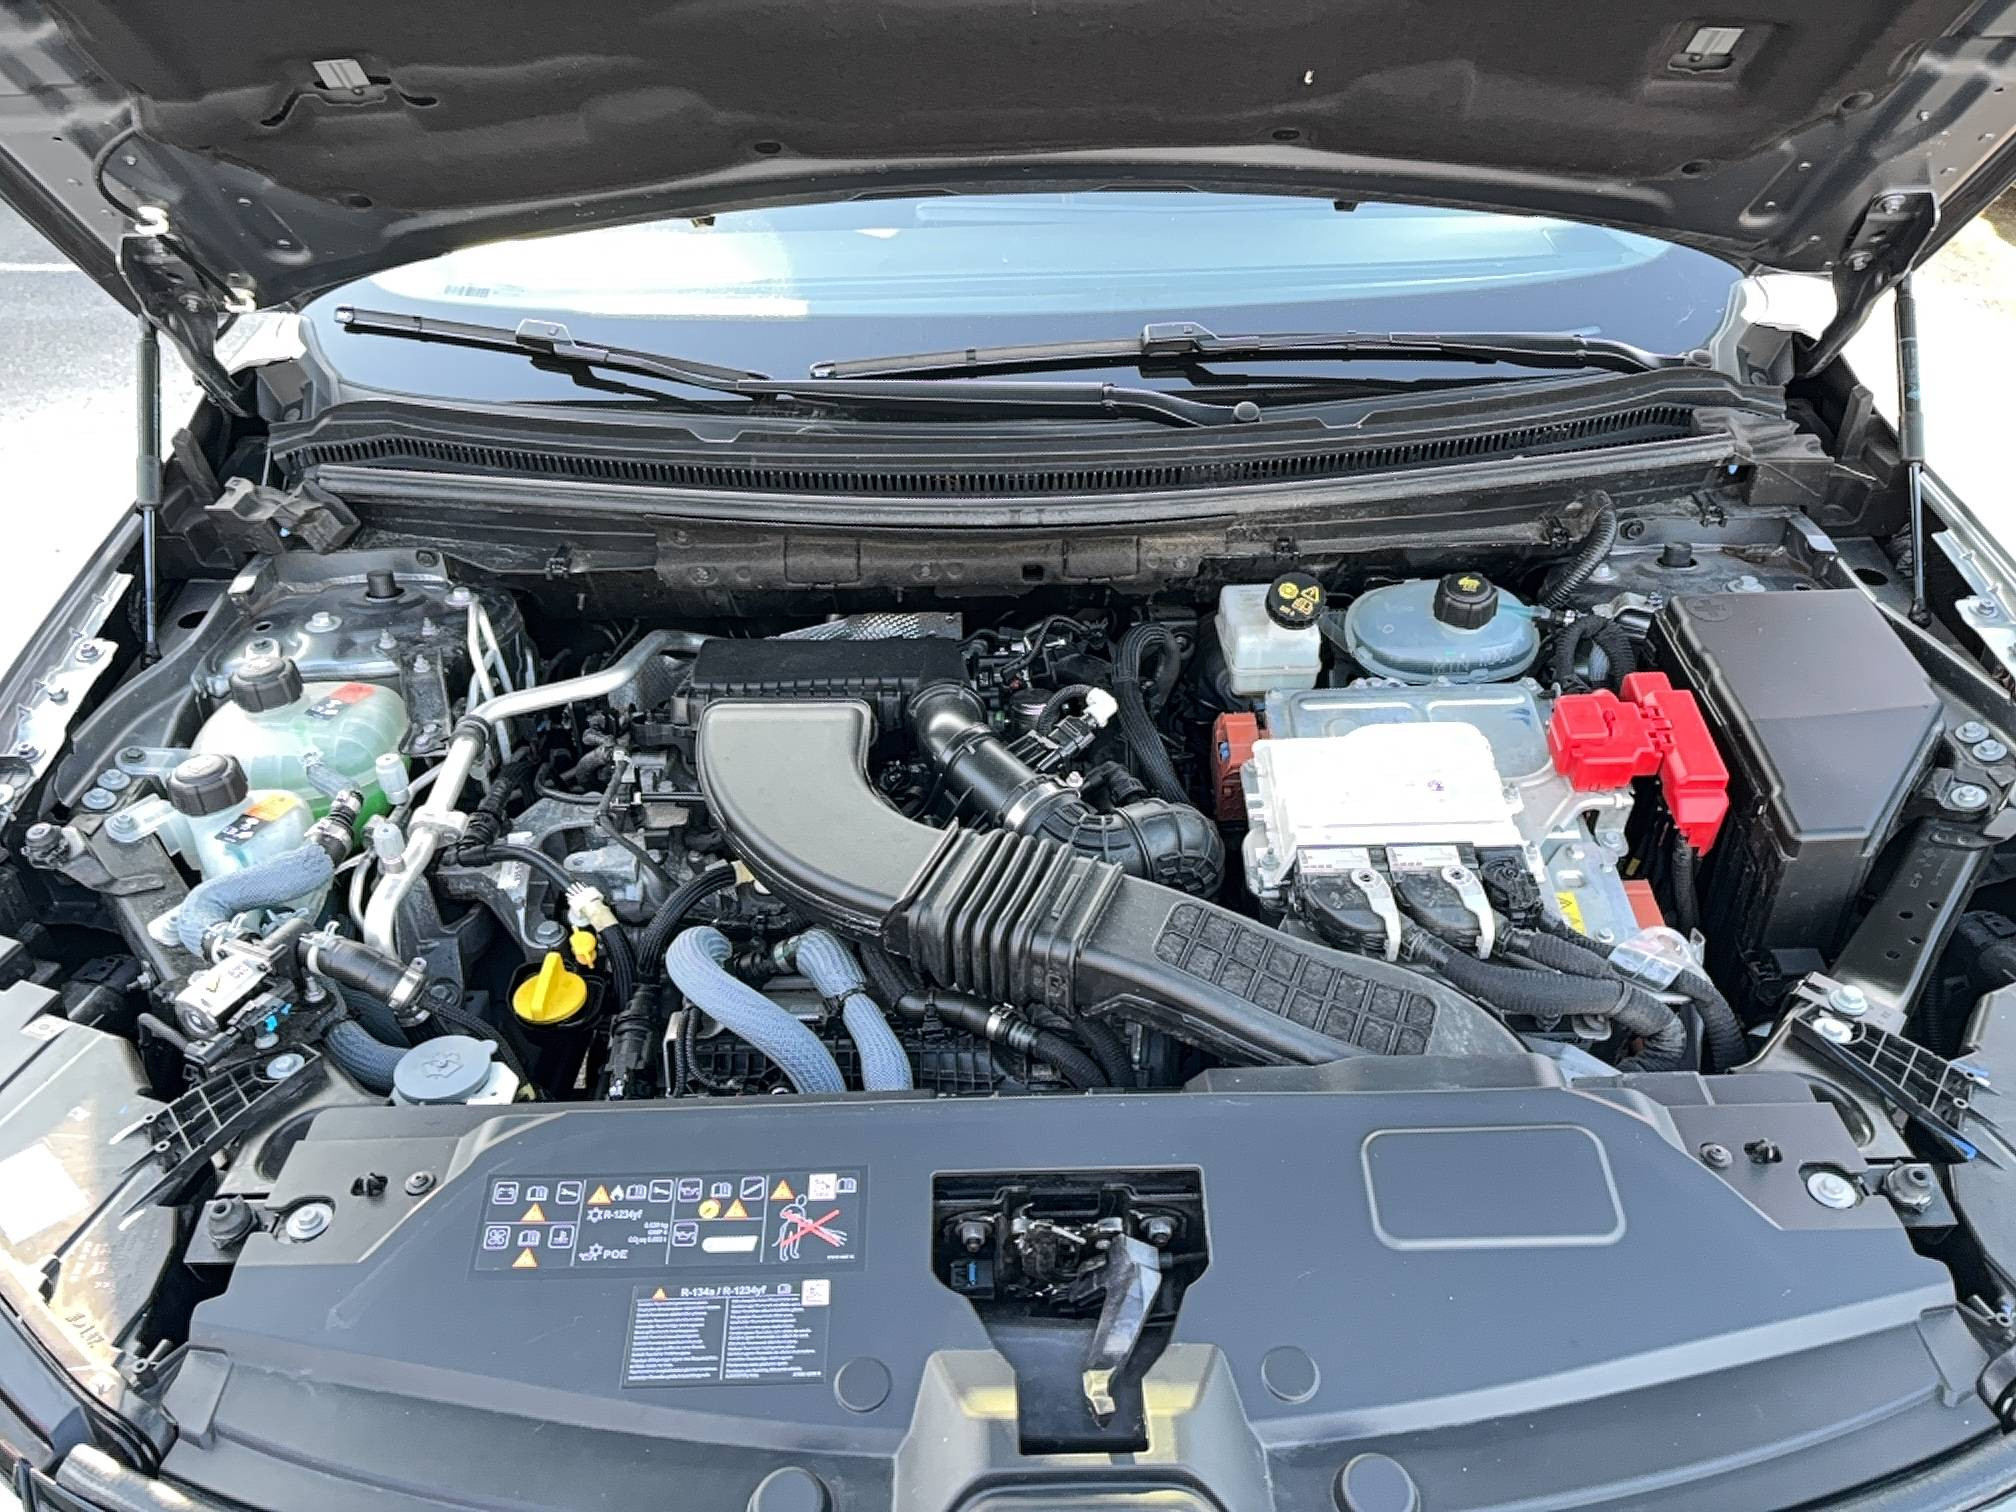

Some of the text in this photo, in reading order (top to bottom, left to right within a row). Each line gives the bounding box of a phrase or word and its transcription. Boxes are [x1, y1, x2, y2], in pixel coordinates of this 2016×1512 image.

[603, 1209, 643, 1221] R-1234yf
[603, 1249, 629, 1260] POE
[681, 1284, 767, 1297] R-134a / R-1234yf
